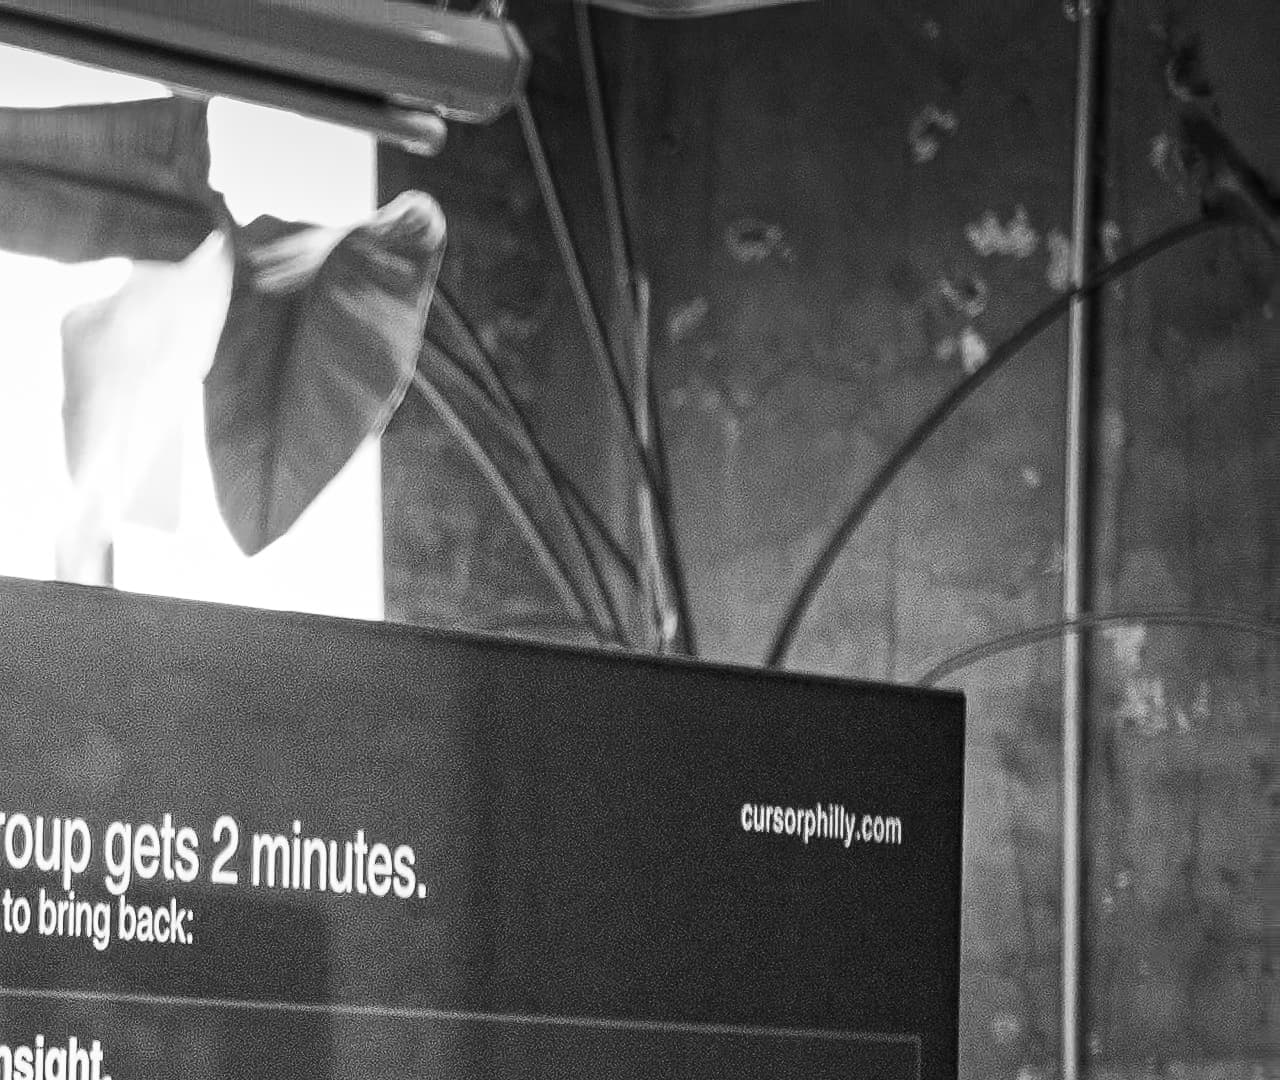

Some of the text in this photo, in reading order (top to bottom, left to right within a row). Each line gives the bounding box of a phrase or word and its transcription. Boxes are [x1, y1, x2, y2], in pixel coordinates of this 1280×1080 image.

[104, 813, 200, 896] gets
[210, 815, 239, 885] 2
[251, 819, 427, 899] minutes.
[740, 803, 902, 848] cursorphilly.com
[2, 888, 31, 934] to
[38, 888, 111, 951] bring
[118, 896, 194, 944] back:
